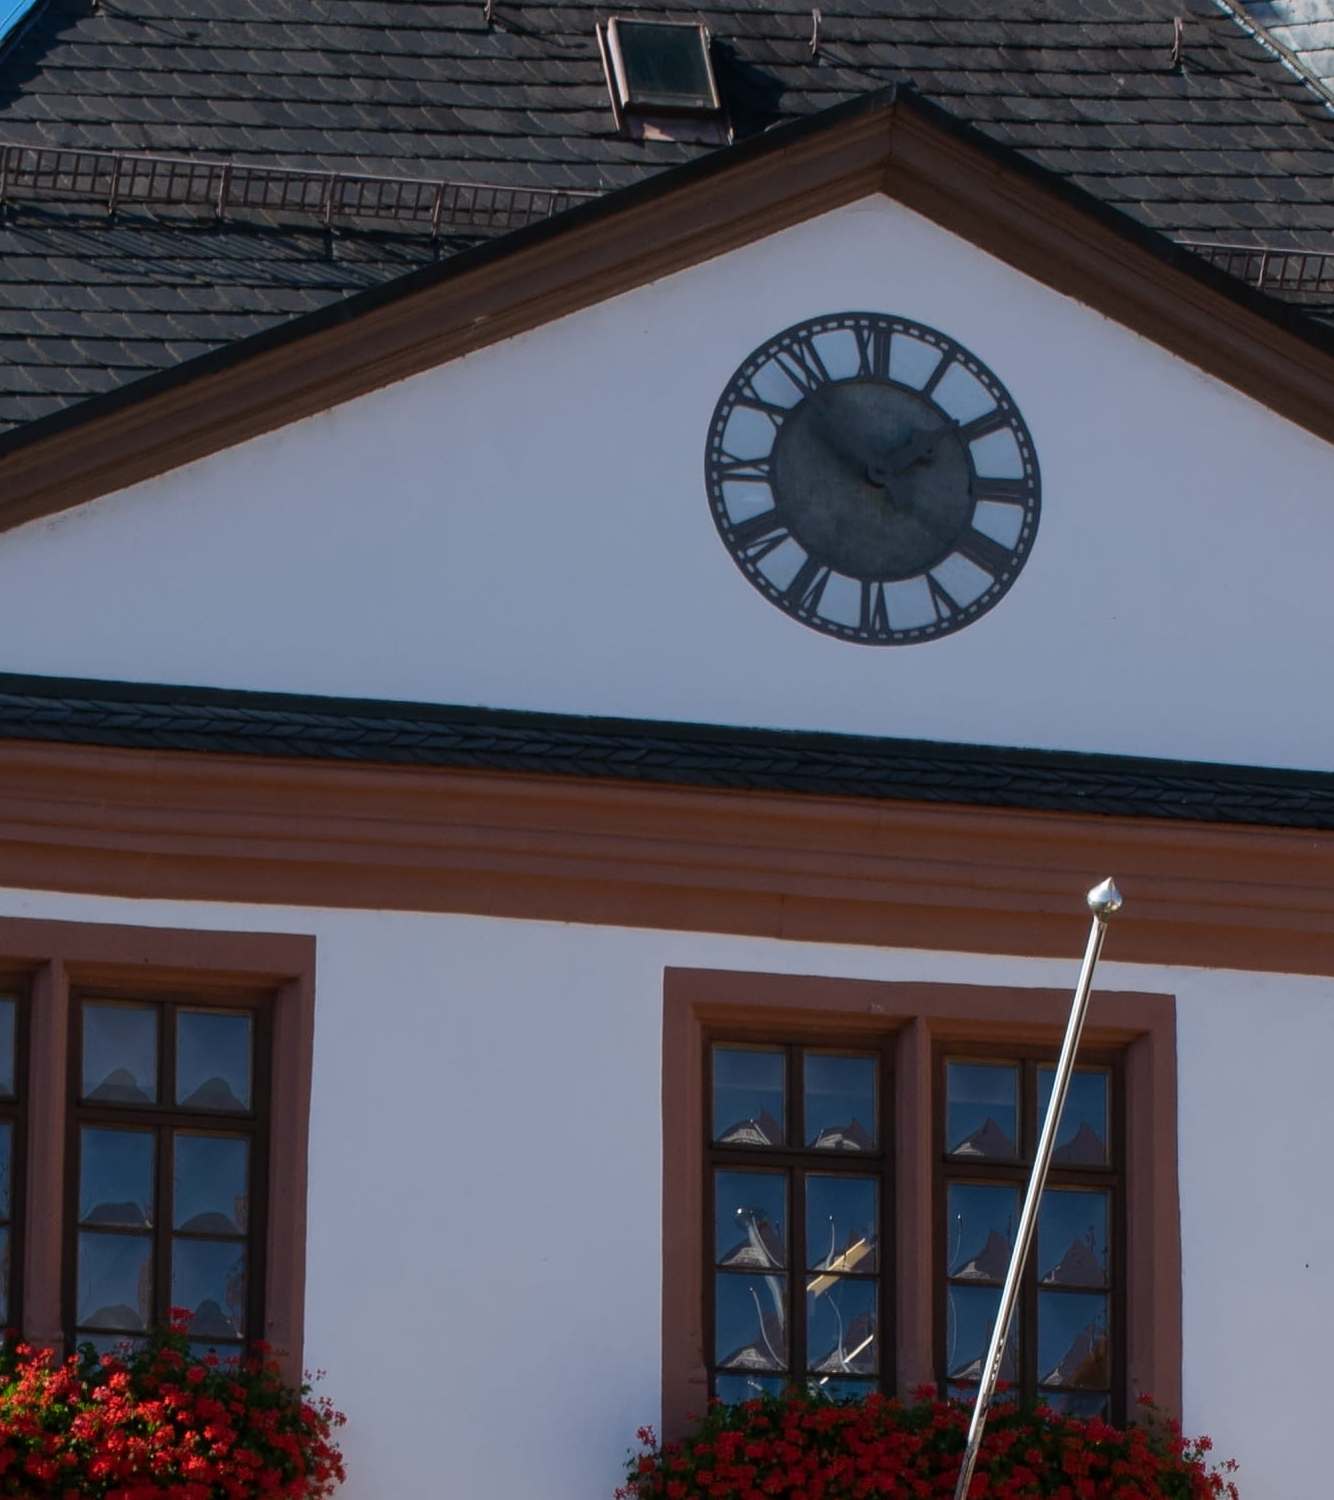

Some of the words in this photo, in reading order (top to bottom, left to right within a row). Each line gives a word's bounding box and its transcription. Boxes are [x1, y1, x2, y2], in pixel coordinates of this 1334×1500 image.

[923, 349, 952, 397] I
[730, 381, 785, 426] X
[925, 573, 964, 620] V
